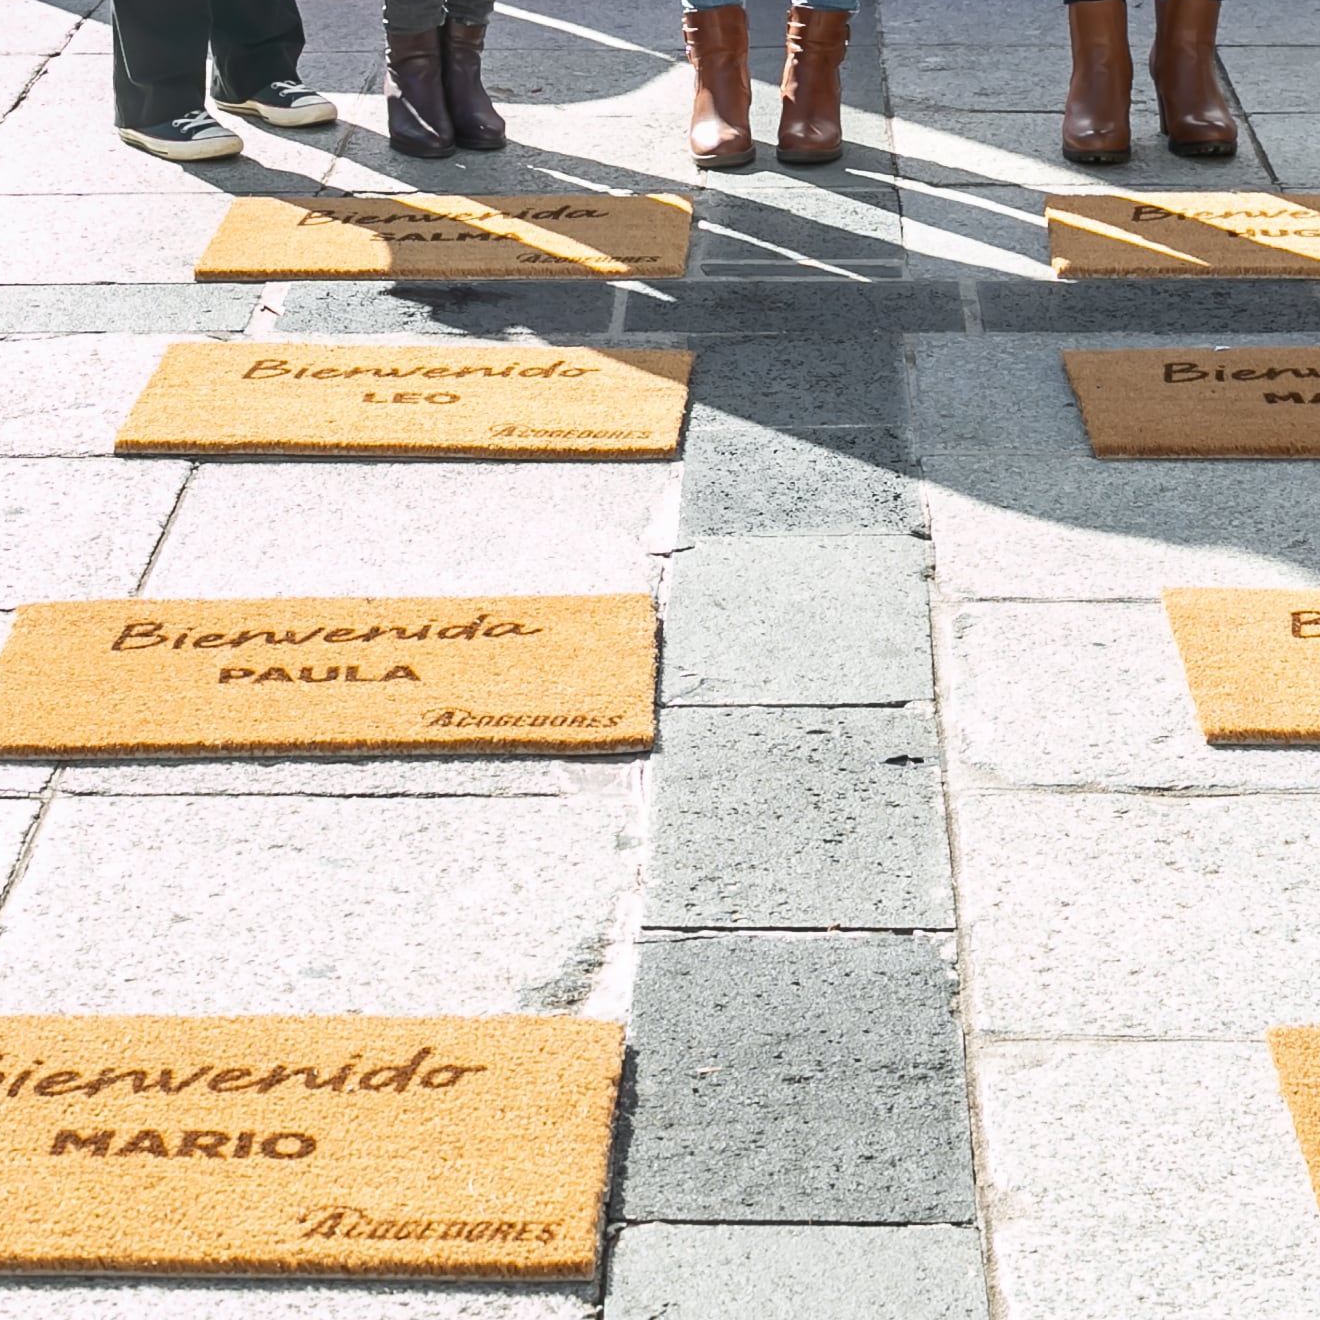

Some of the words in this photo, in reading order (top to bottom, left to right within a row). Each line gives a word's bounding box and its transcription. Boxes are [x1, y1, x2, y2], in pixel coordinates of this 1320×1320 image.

[297, 204, 610, 226] Bienvenida
[370, 231, 524, 243] SALMA
[242, 358, 602, 381] Bienvenido
[362, 391, 462, 405] LEO
[110, 613, 544, 652] Bienvenida
[218, 664, 423, 685] PAULA
[48, 1127, 319, 1161] MARIO
[296, 1203, 564, 1245] ACOGEDORES
